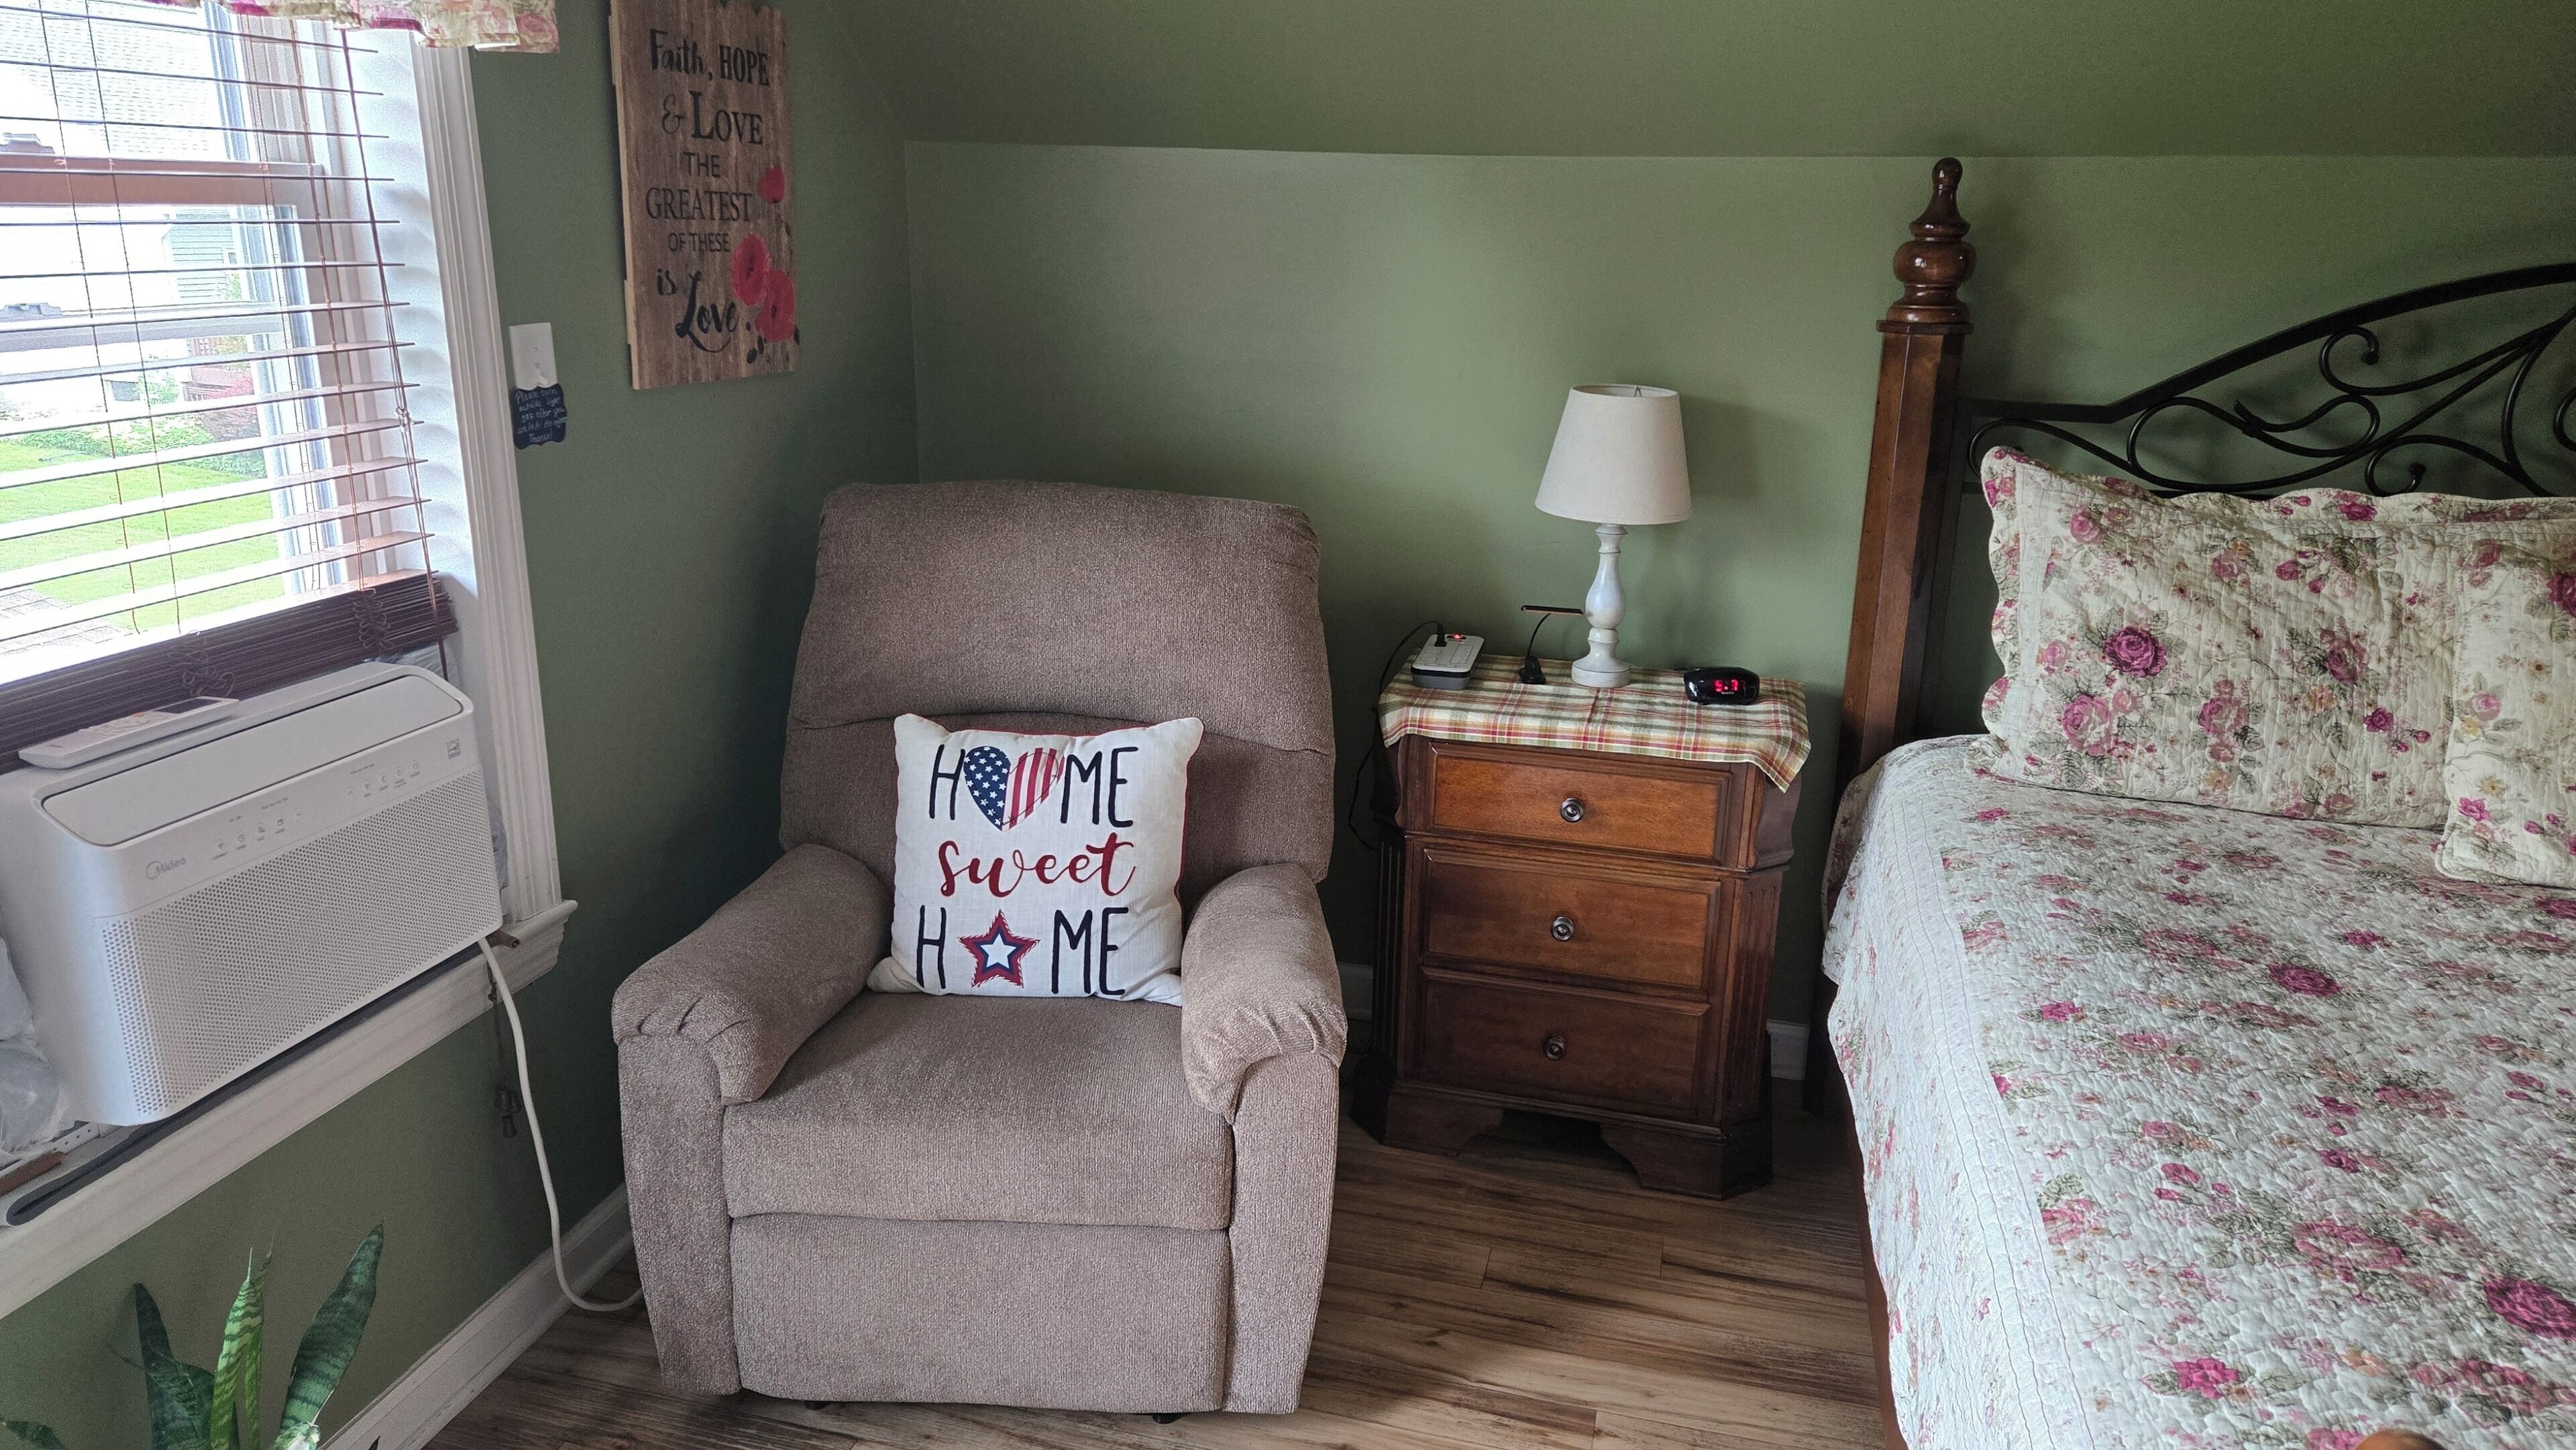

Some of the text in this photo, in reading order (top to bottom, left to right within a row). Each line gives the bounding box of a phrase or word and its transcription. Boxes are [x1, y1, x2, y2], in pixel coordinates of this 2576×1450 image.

[649, 28, 770, 86] Faith, HOPE
[661, 91, 763, 145] & LOVE
[683, 152, 721, 178] THE
[645, 187, 753, 221] GREATEST
[668, 233, 731, 252] OF THESE
[657, 268, 739, 353] is Love
[146, 857, 186, 880] Midea
[938, 832, 1136, 898] sweet
